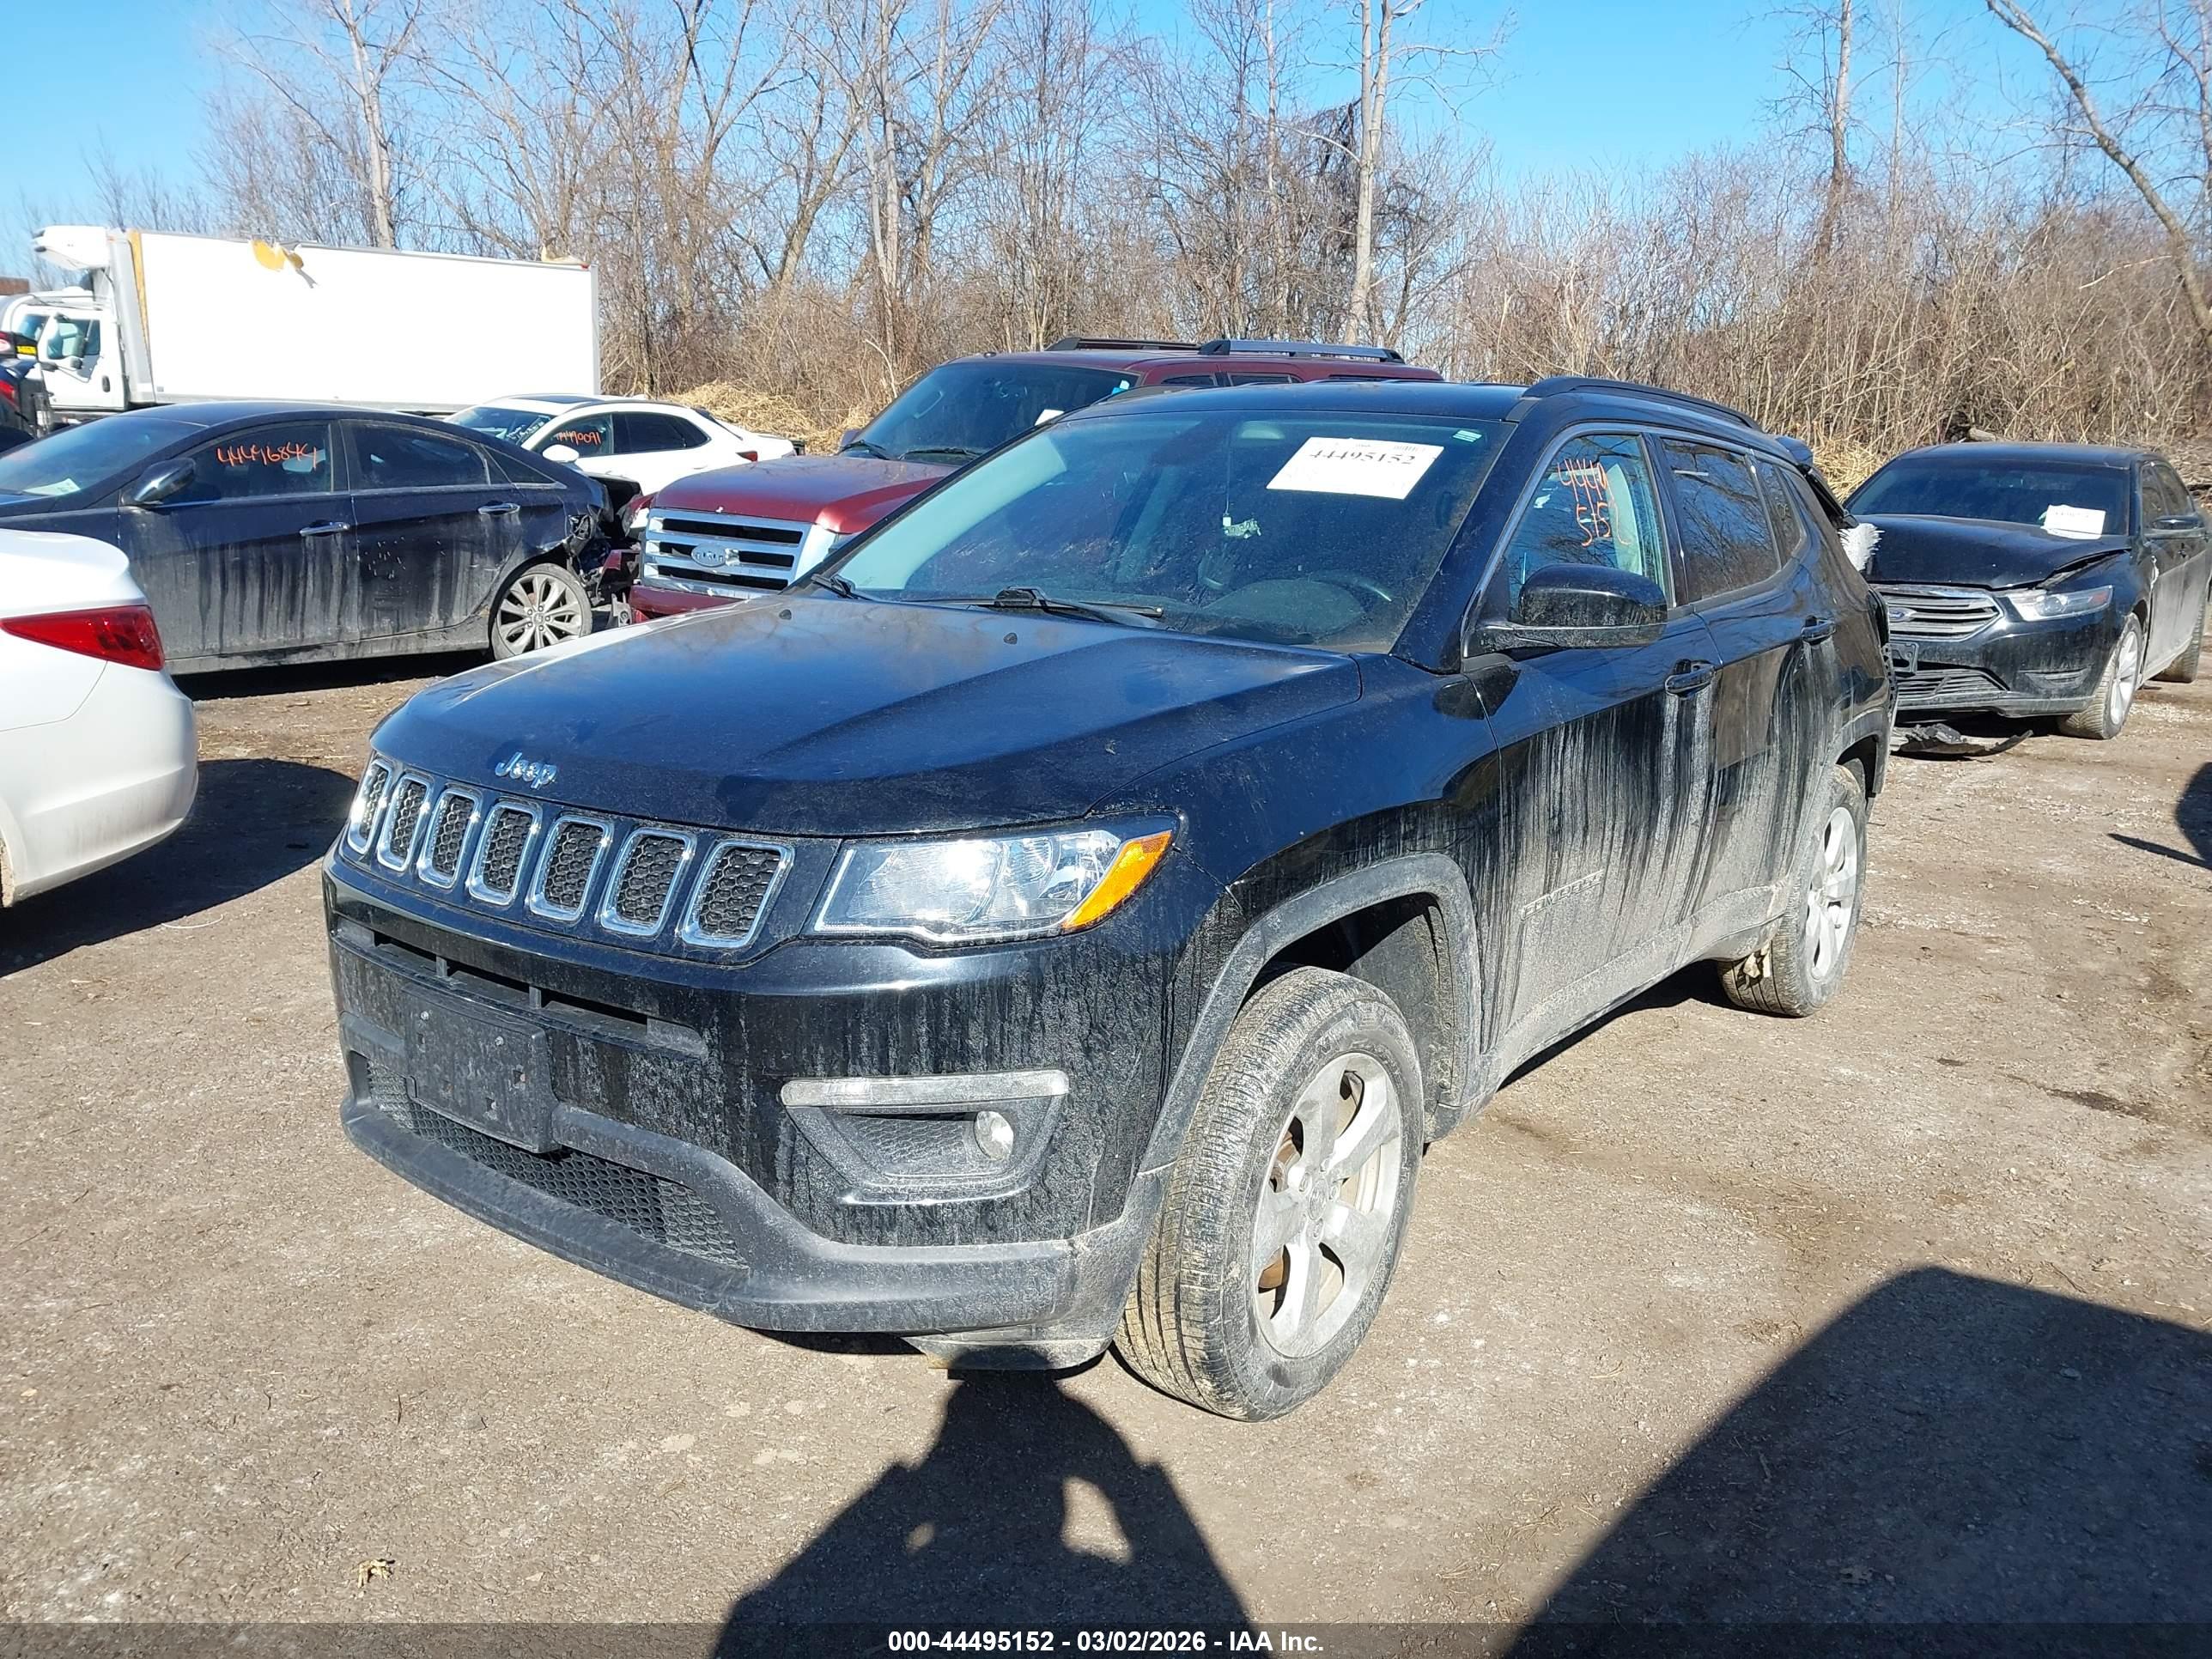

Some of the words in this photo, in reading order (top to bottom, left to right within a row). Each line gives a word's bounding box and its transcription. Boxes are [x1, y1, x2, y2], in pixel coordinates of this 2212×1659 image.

[217, 441, 317, 471] 44496844
[1310, 449, 1416, 465] 44495152
[495, 751, 557, 790] Jeep
